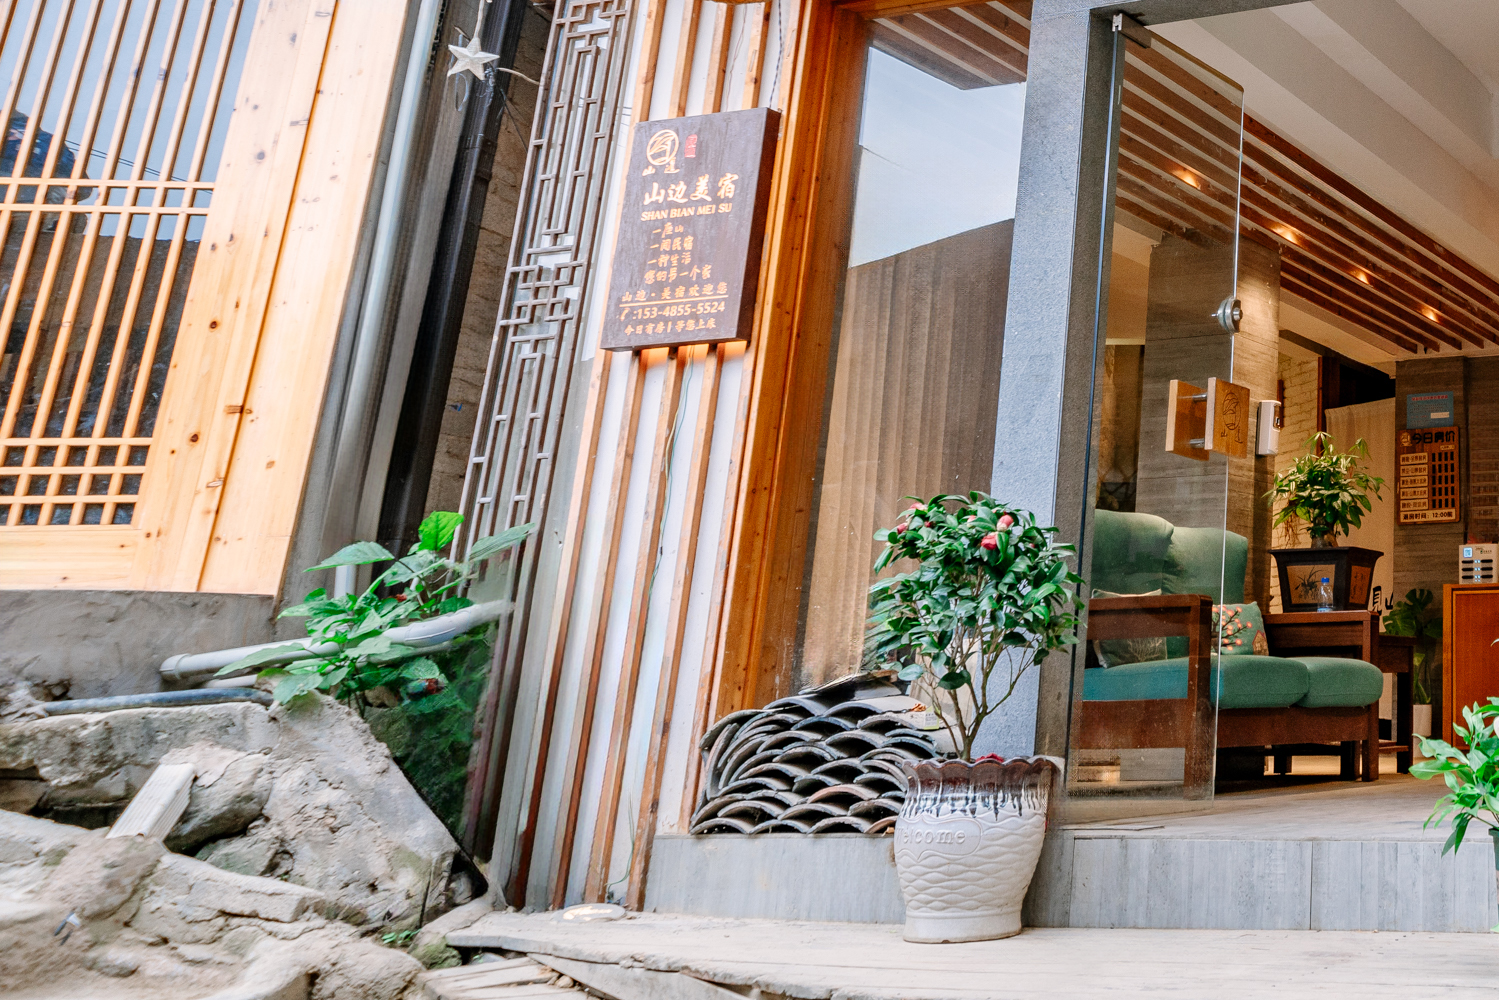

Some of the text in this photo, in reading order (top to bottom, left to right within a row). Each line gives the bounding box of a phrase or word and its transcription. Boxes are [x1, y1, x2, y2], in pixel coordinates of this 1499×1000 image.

[643, 172, 739, 206] 山边美宿
[641, 202, 733, 221] SHAN BIAN MEI SU
[652, 221, 684, 238] 一座山
[650, 235, 694, 251] 一间民宿
[647, 251, 692, 267] 一种生活
[644, 264, 712, 285] 您的另一个家
[1412, 430, 1456, 445] 今日房价
